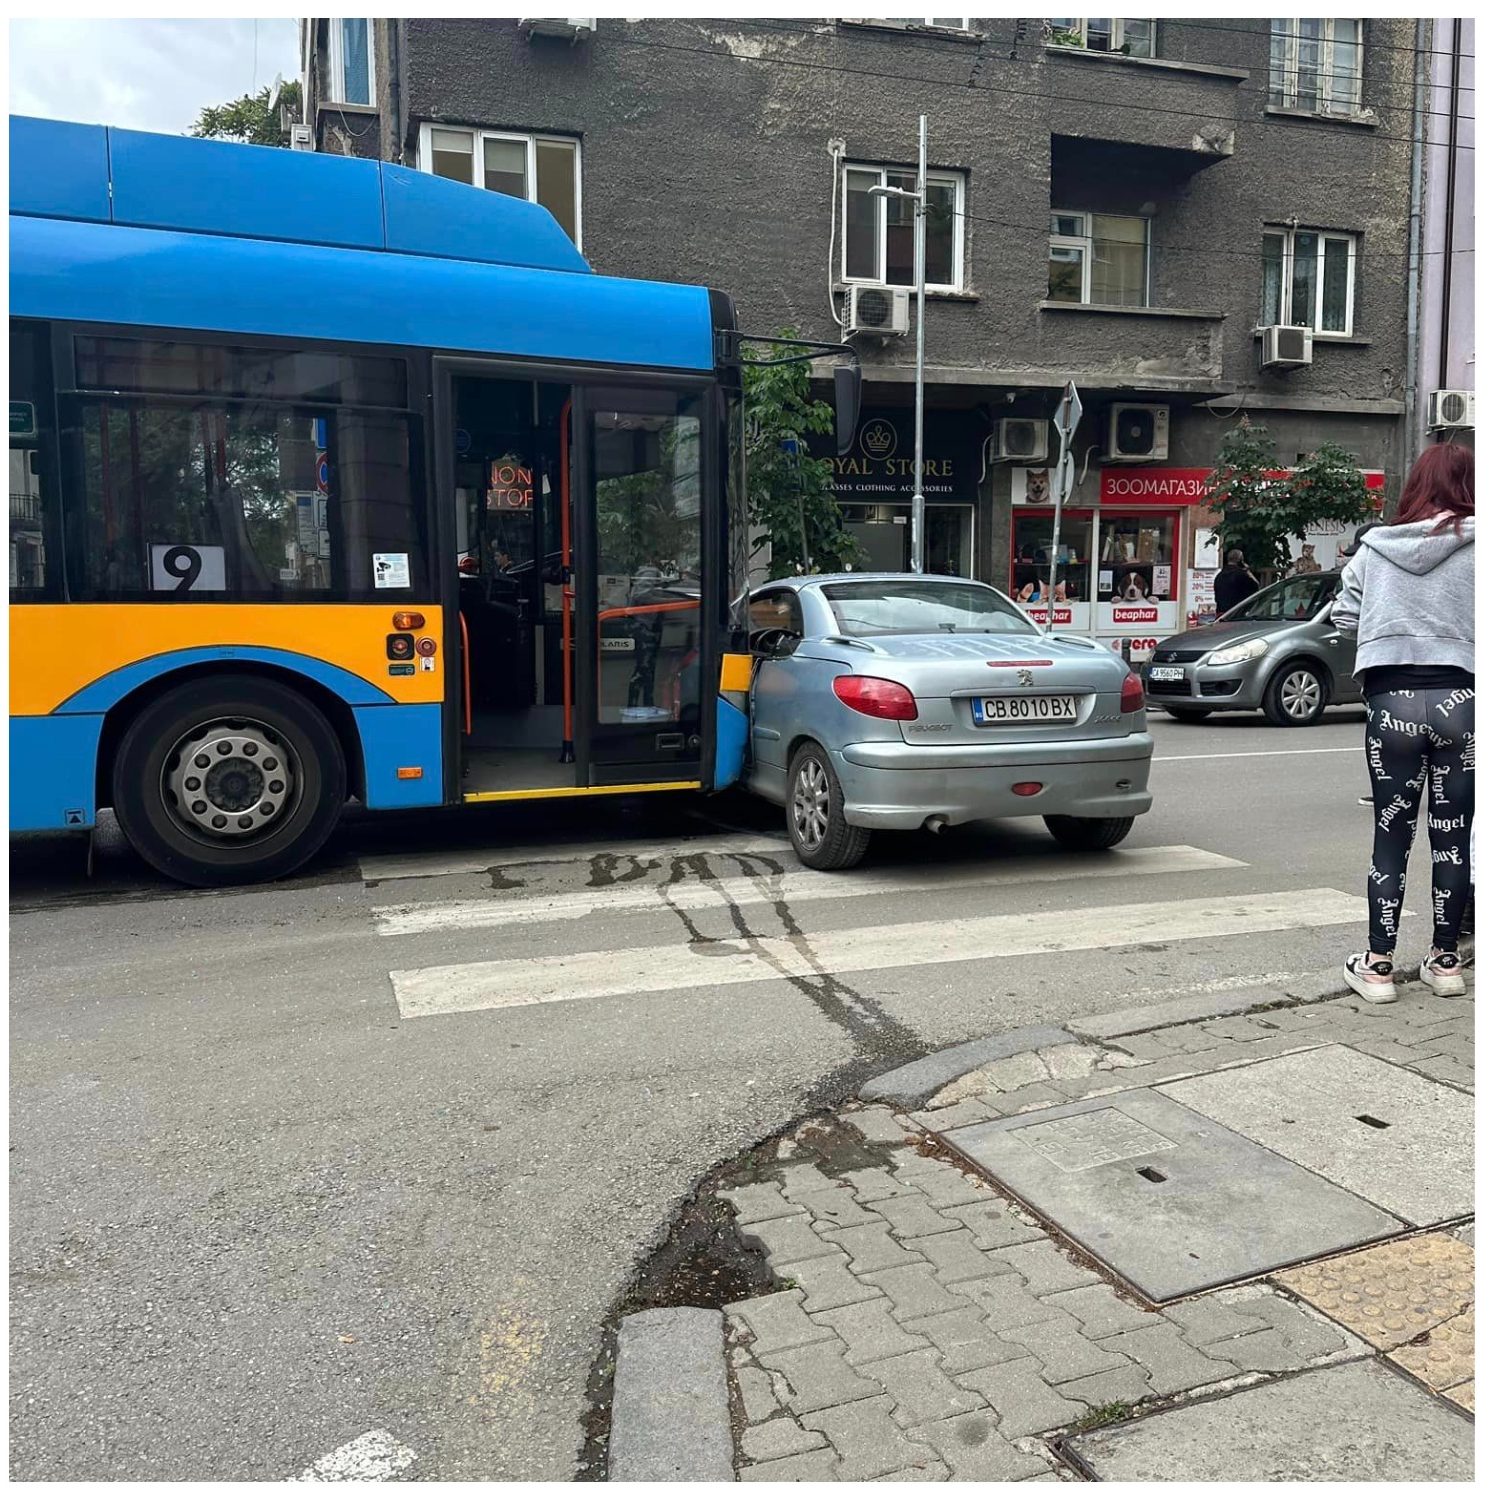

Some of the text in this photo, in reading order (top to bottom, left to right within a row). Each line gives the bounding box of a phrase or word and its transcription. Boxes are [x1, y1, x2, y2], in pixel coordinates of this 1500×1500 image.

[822, 457, 873, 475] OYAL
[856, 484, 896, 492] CLOTHING
[163, 546, 202, 591] 9
[1027, 610, 1069, 624] beahar
[1115, 609, 1156, 623] beaphar
[1010, 699, 1049, 717] 8010
[1435, 688, 1476, 718] ngel
[1368, 736, 1393, 781] Angel
[1430, 764, 1451, 805] Angel
[1378, 794, 1412, 832] Angel
[1377, 897, 1400, 938] Angel
[1432, 886, 1452, 926] Angel
